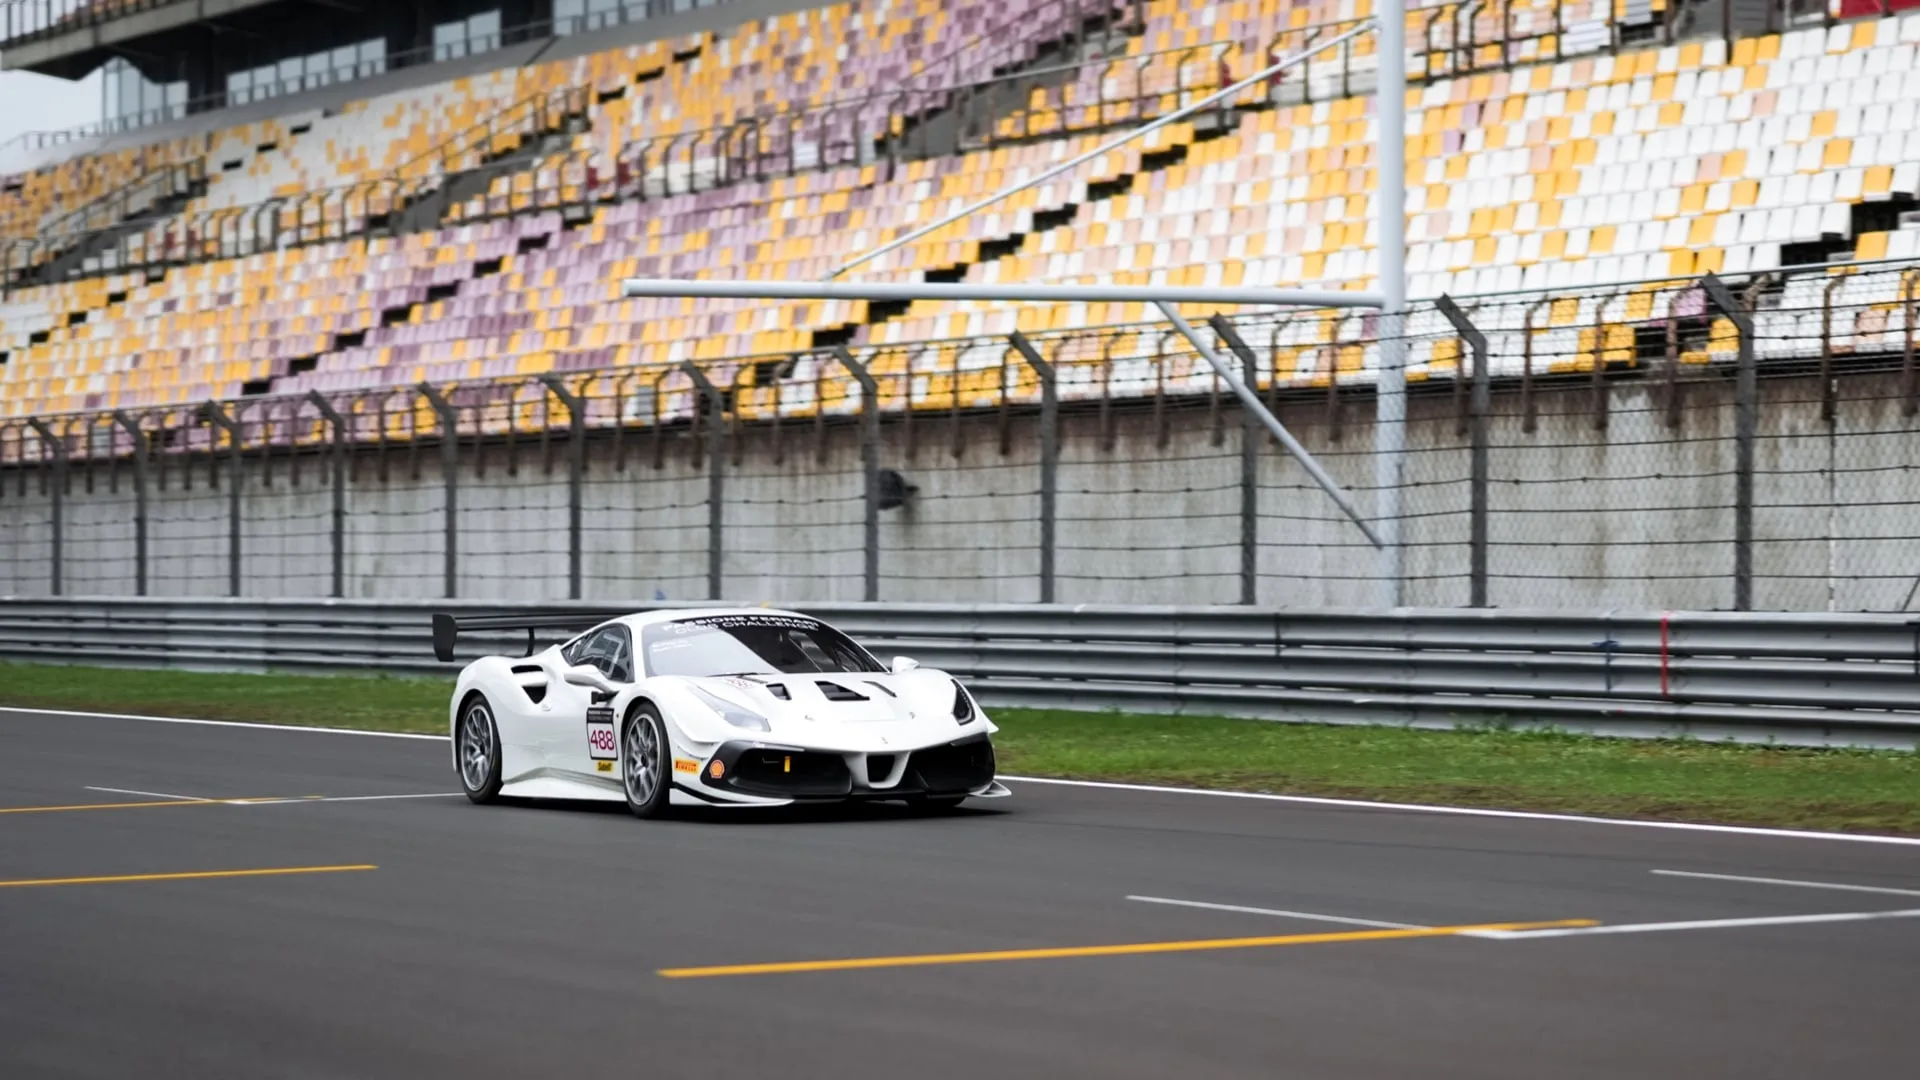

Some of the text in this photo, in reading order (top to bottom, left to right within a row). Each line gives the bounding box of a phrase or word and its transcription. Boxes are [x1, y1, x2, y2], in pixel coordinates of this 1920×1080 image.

[722, 620, 819, 632] CHALLENGE
[749, 616, 819, 628] FERRARI
[590, 729, 615, 751] 488
